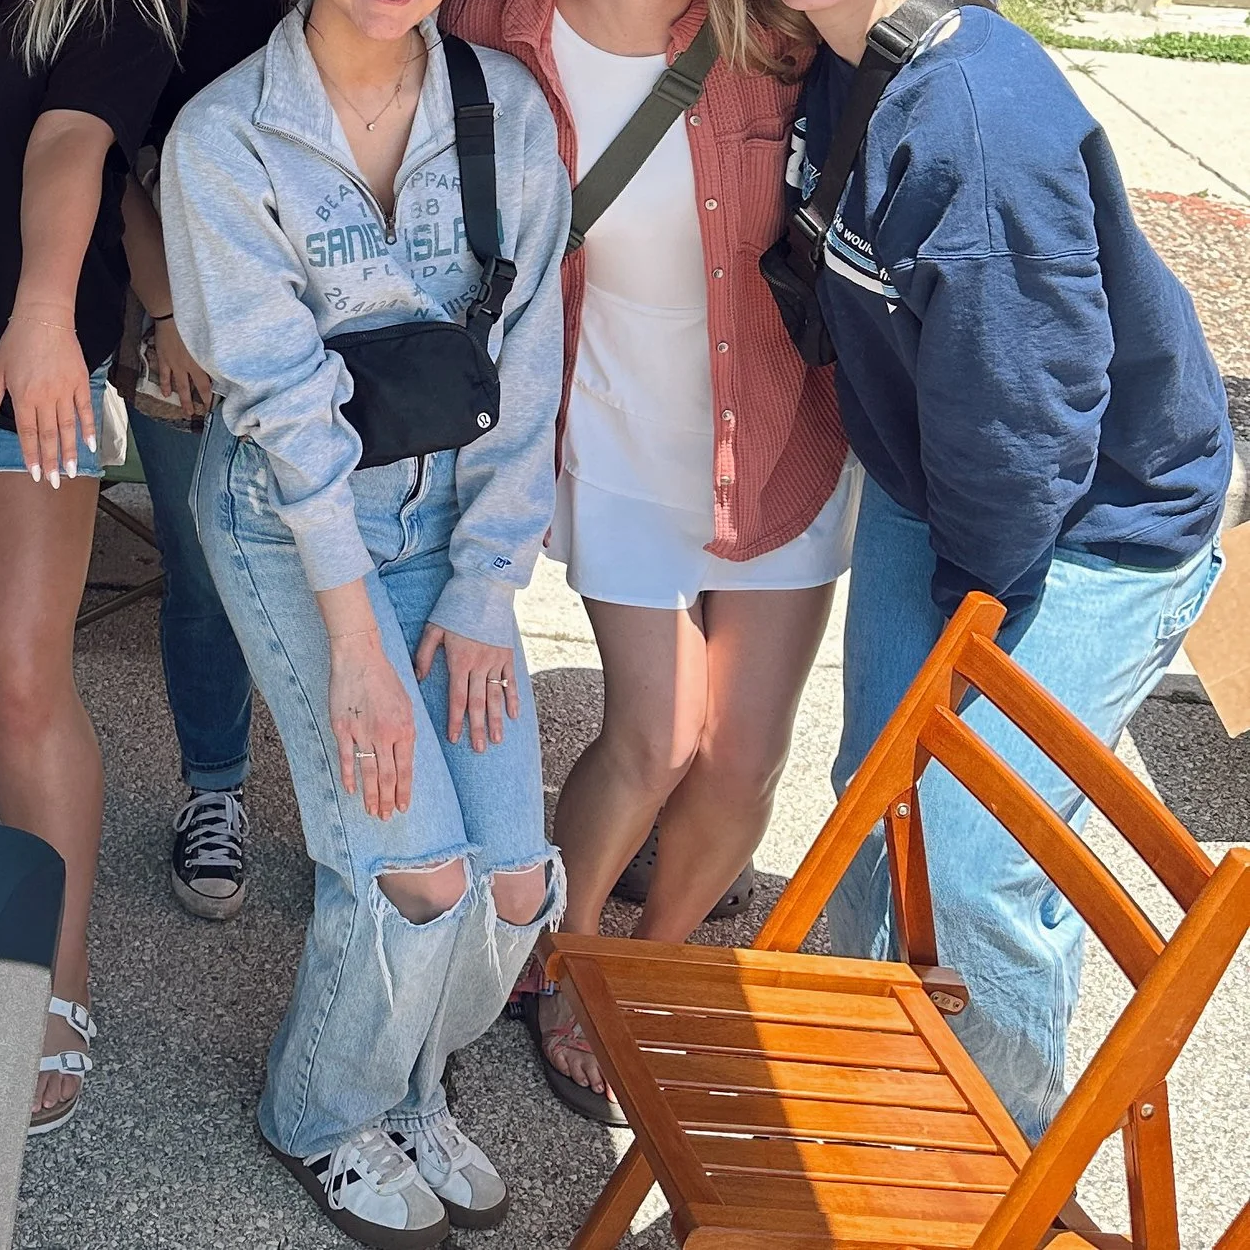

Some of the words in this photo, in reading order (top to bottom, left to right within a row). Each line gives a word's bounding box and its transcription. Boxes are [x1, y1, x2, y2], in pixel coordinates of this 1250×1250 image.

[315, 184, 354, 222] BEA
[410, 171, 461, 193] PPAR
[306, 222, 390, 268] SANIB
